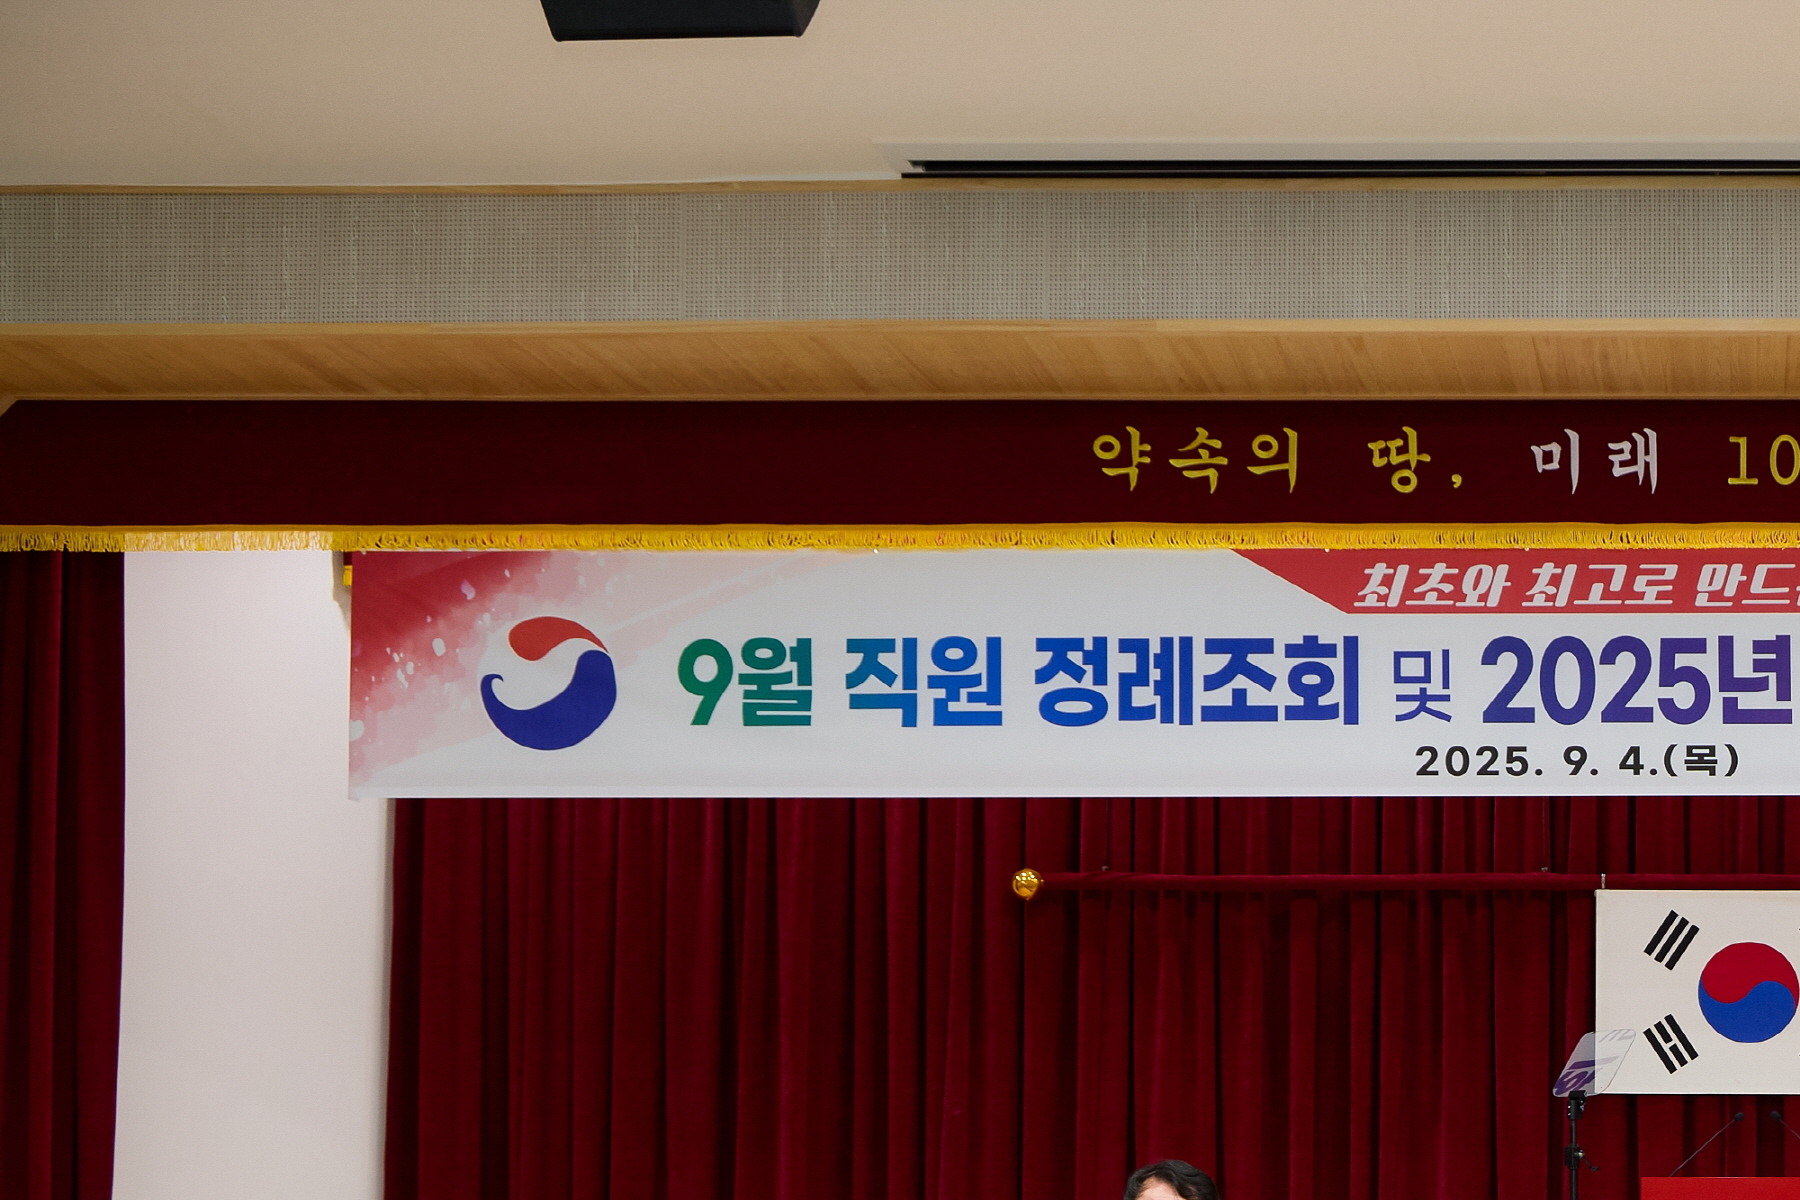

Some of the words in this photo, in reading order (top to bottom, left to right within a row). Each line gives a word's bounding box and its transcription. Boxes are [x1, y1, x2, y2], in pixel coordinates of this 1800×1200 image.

[1093, 425, 1299, 494] 약속의
[1367, 426, 1463, 494] 땅,
[1530, 427, 1658, 495] 미래
[1354, 562, 1512, 608] 최초와
[1521, 562, 1679, 607] 최고로
[677, 636, 813, 727] 9월
[845, 635, 1003, 728] 직원
[1034, 634, 1359, 727] 정례조회
[1393, 648, 1452, 723] 및
[1480, 634, 1793, 726] 2025년
[1415, 745, 1543, 777] 2025.
[1563, 745, 1599, 776] 9.
[1618, 743, 1739, 777] 4.(목)
